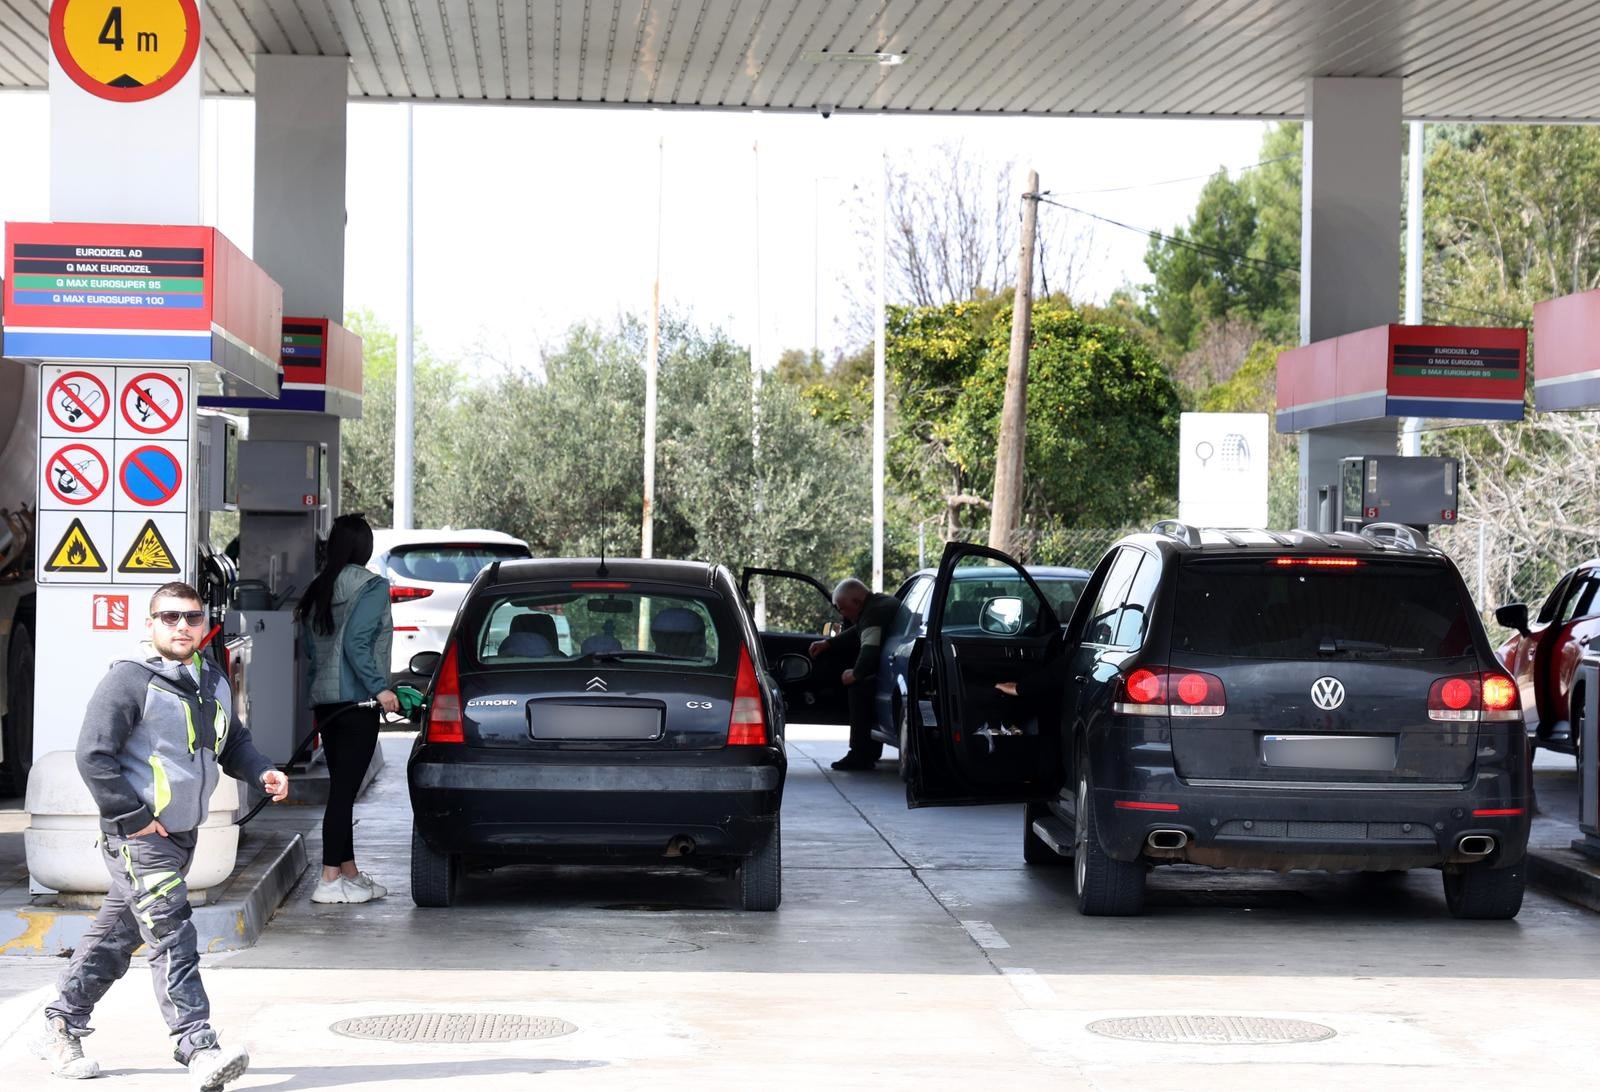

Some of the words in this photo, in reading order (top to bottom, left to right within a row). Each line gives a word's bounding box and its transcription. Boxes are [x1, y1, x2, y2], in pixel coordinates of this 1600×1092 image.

[98, 6, 124, 51] 4
[137, 32, 158, 52] m
[76, 247, 126, 258] EURODIZEL
[128, 249, 143, 258] AD
[76, 263, 99, 273] MAX
[100, 265, 151, 273] EURODIZEL
[66, 279, 88, 288] MAX
[90, 280, 146, 289] EUROSUPER
[148, 281, 161, 290] 95
[63, 295, 85, 304] MAX
[87, 295, 143, 305] EUROSUPER
[145, 297, 164, 305] 100
[306, 495, 313, 505] 8
[1368, 508, 1376, 518] 5
[1444, 510, 1451, 520] 6
